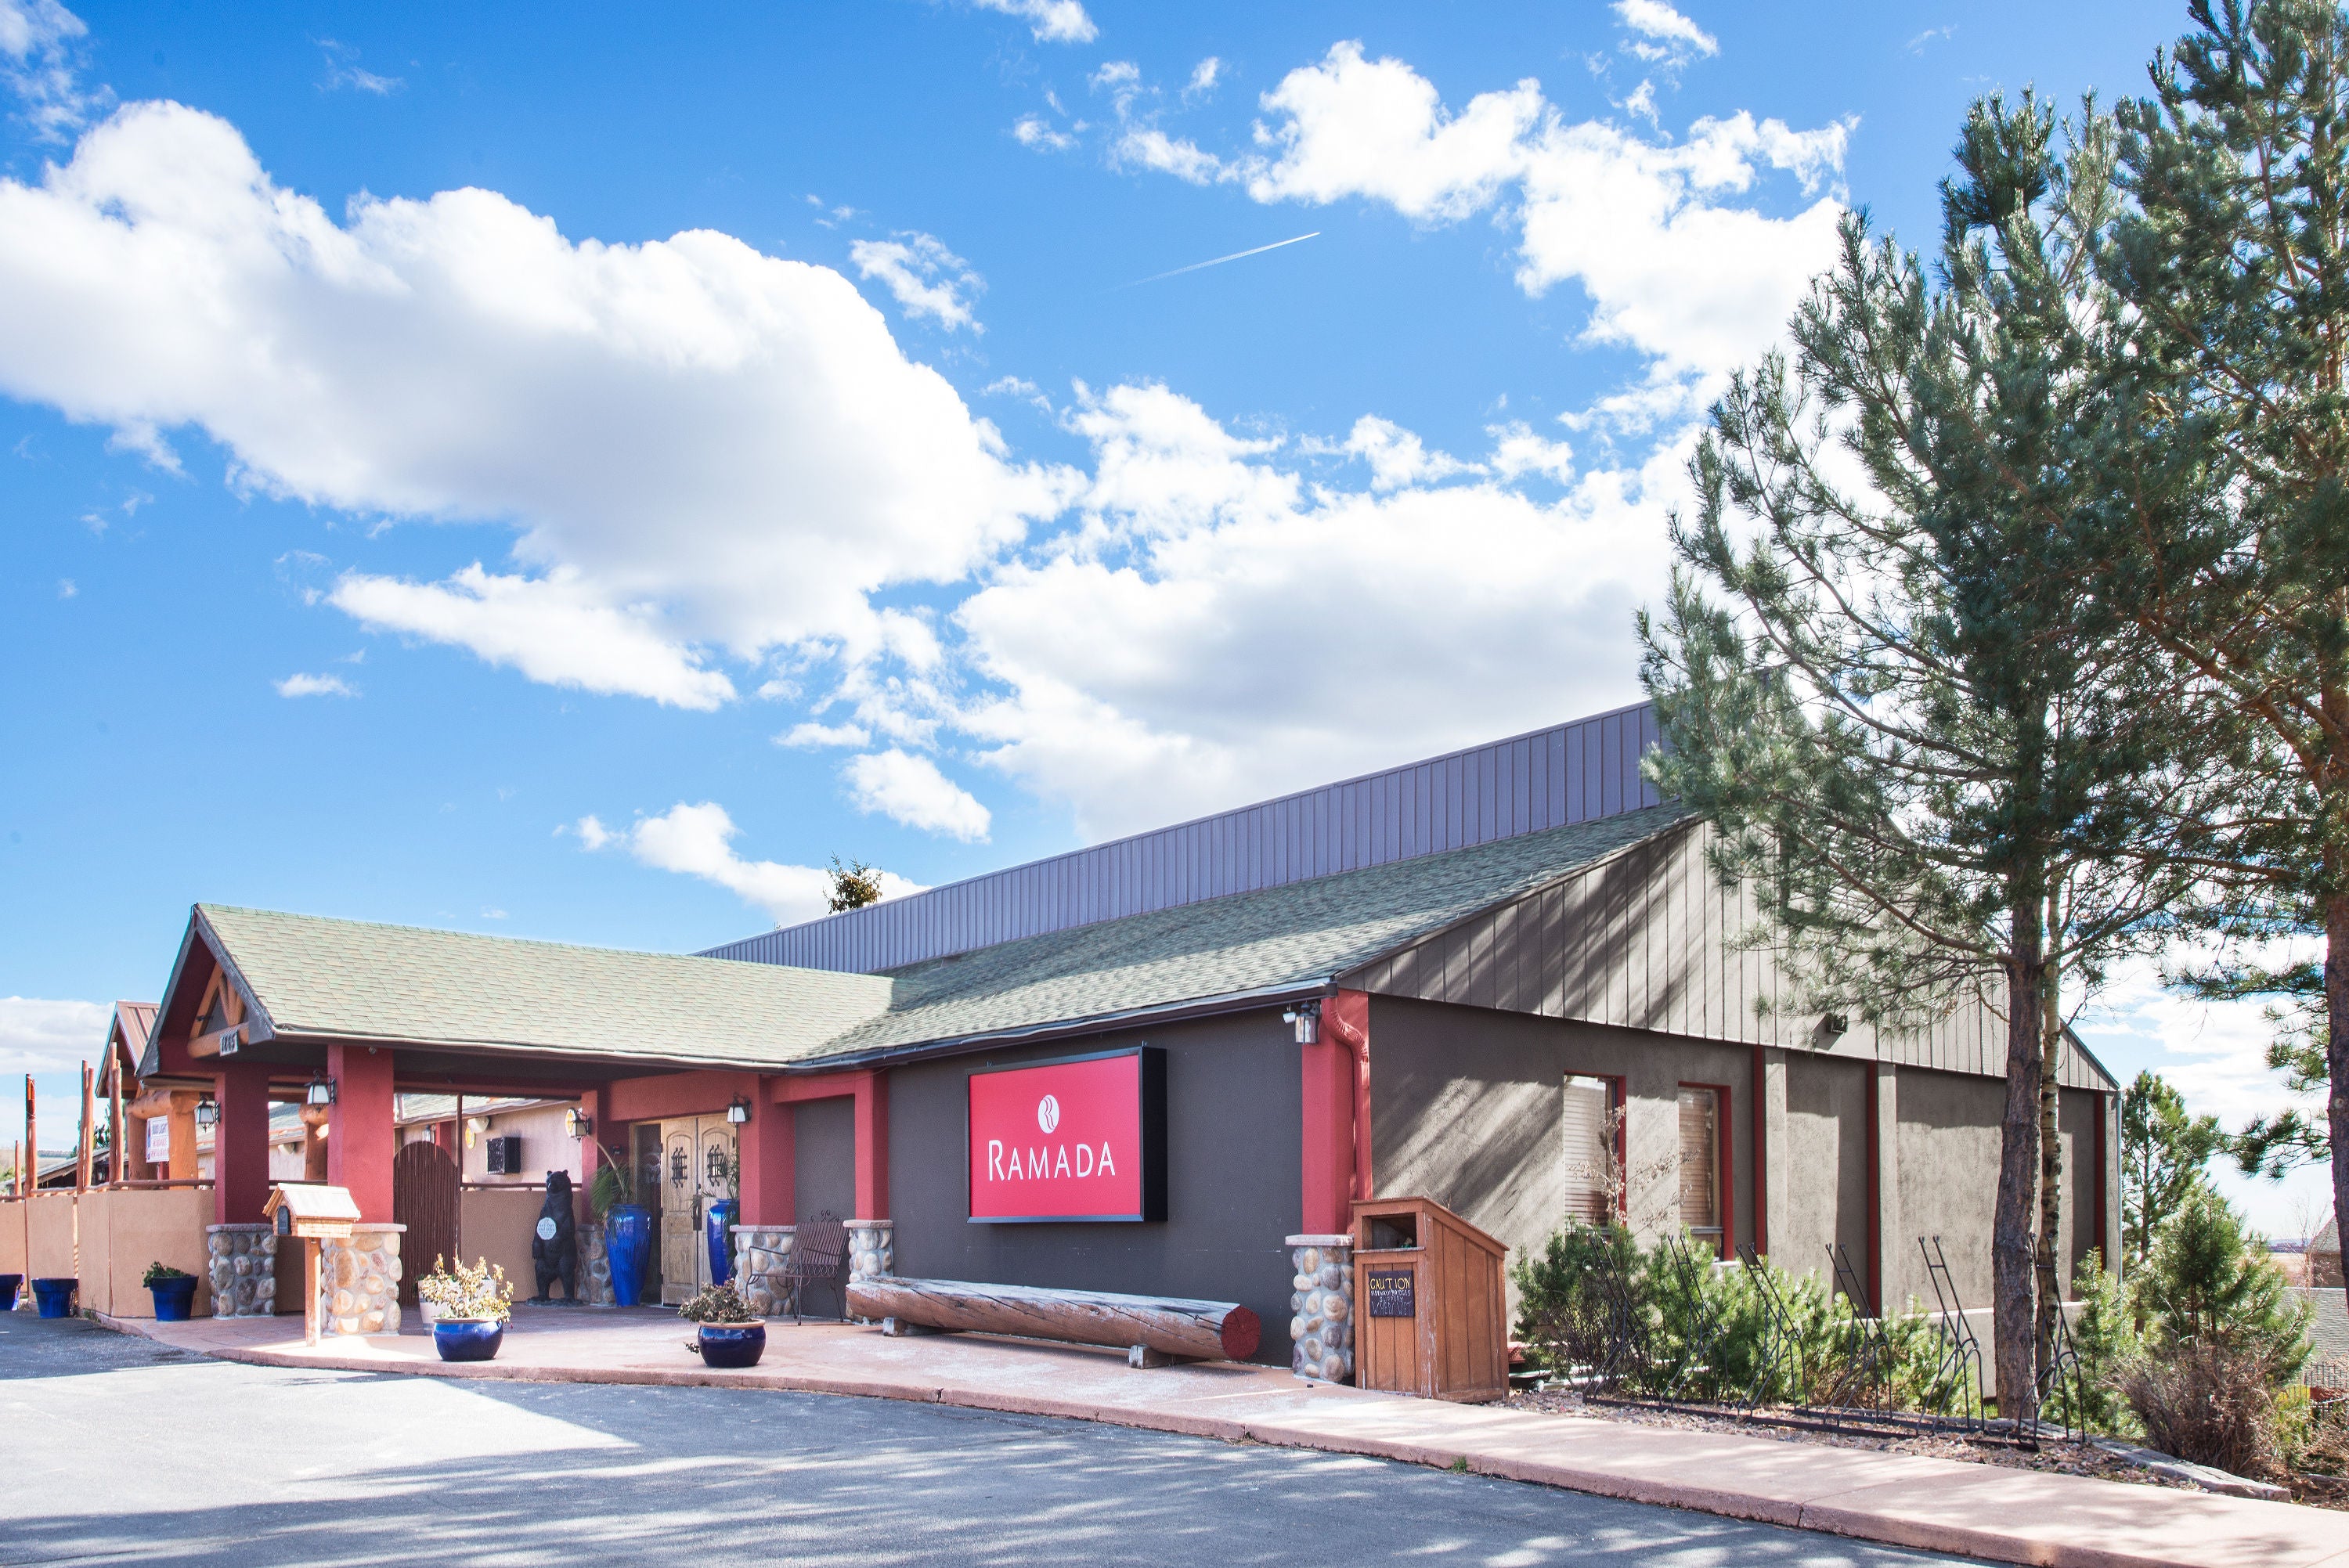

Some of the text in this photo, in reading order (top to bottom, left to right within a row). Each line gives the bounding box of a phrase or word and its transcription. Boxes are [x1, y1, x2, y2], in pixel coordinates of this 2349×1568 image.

[988, 1139, 1116, 1181] RAMADA
[1370, 1276, 1411, 1290] CAUTION
[1371, 1300, 1412, 1315] WHEN WET
